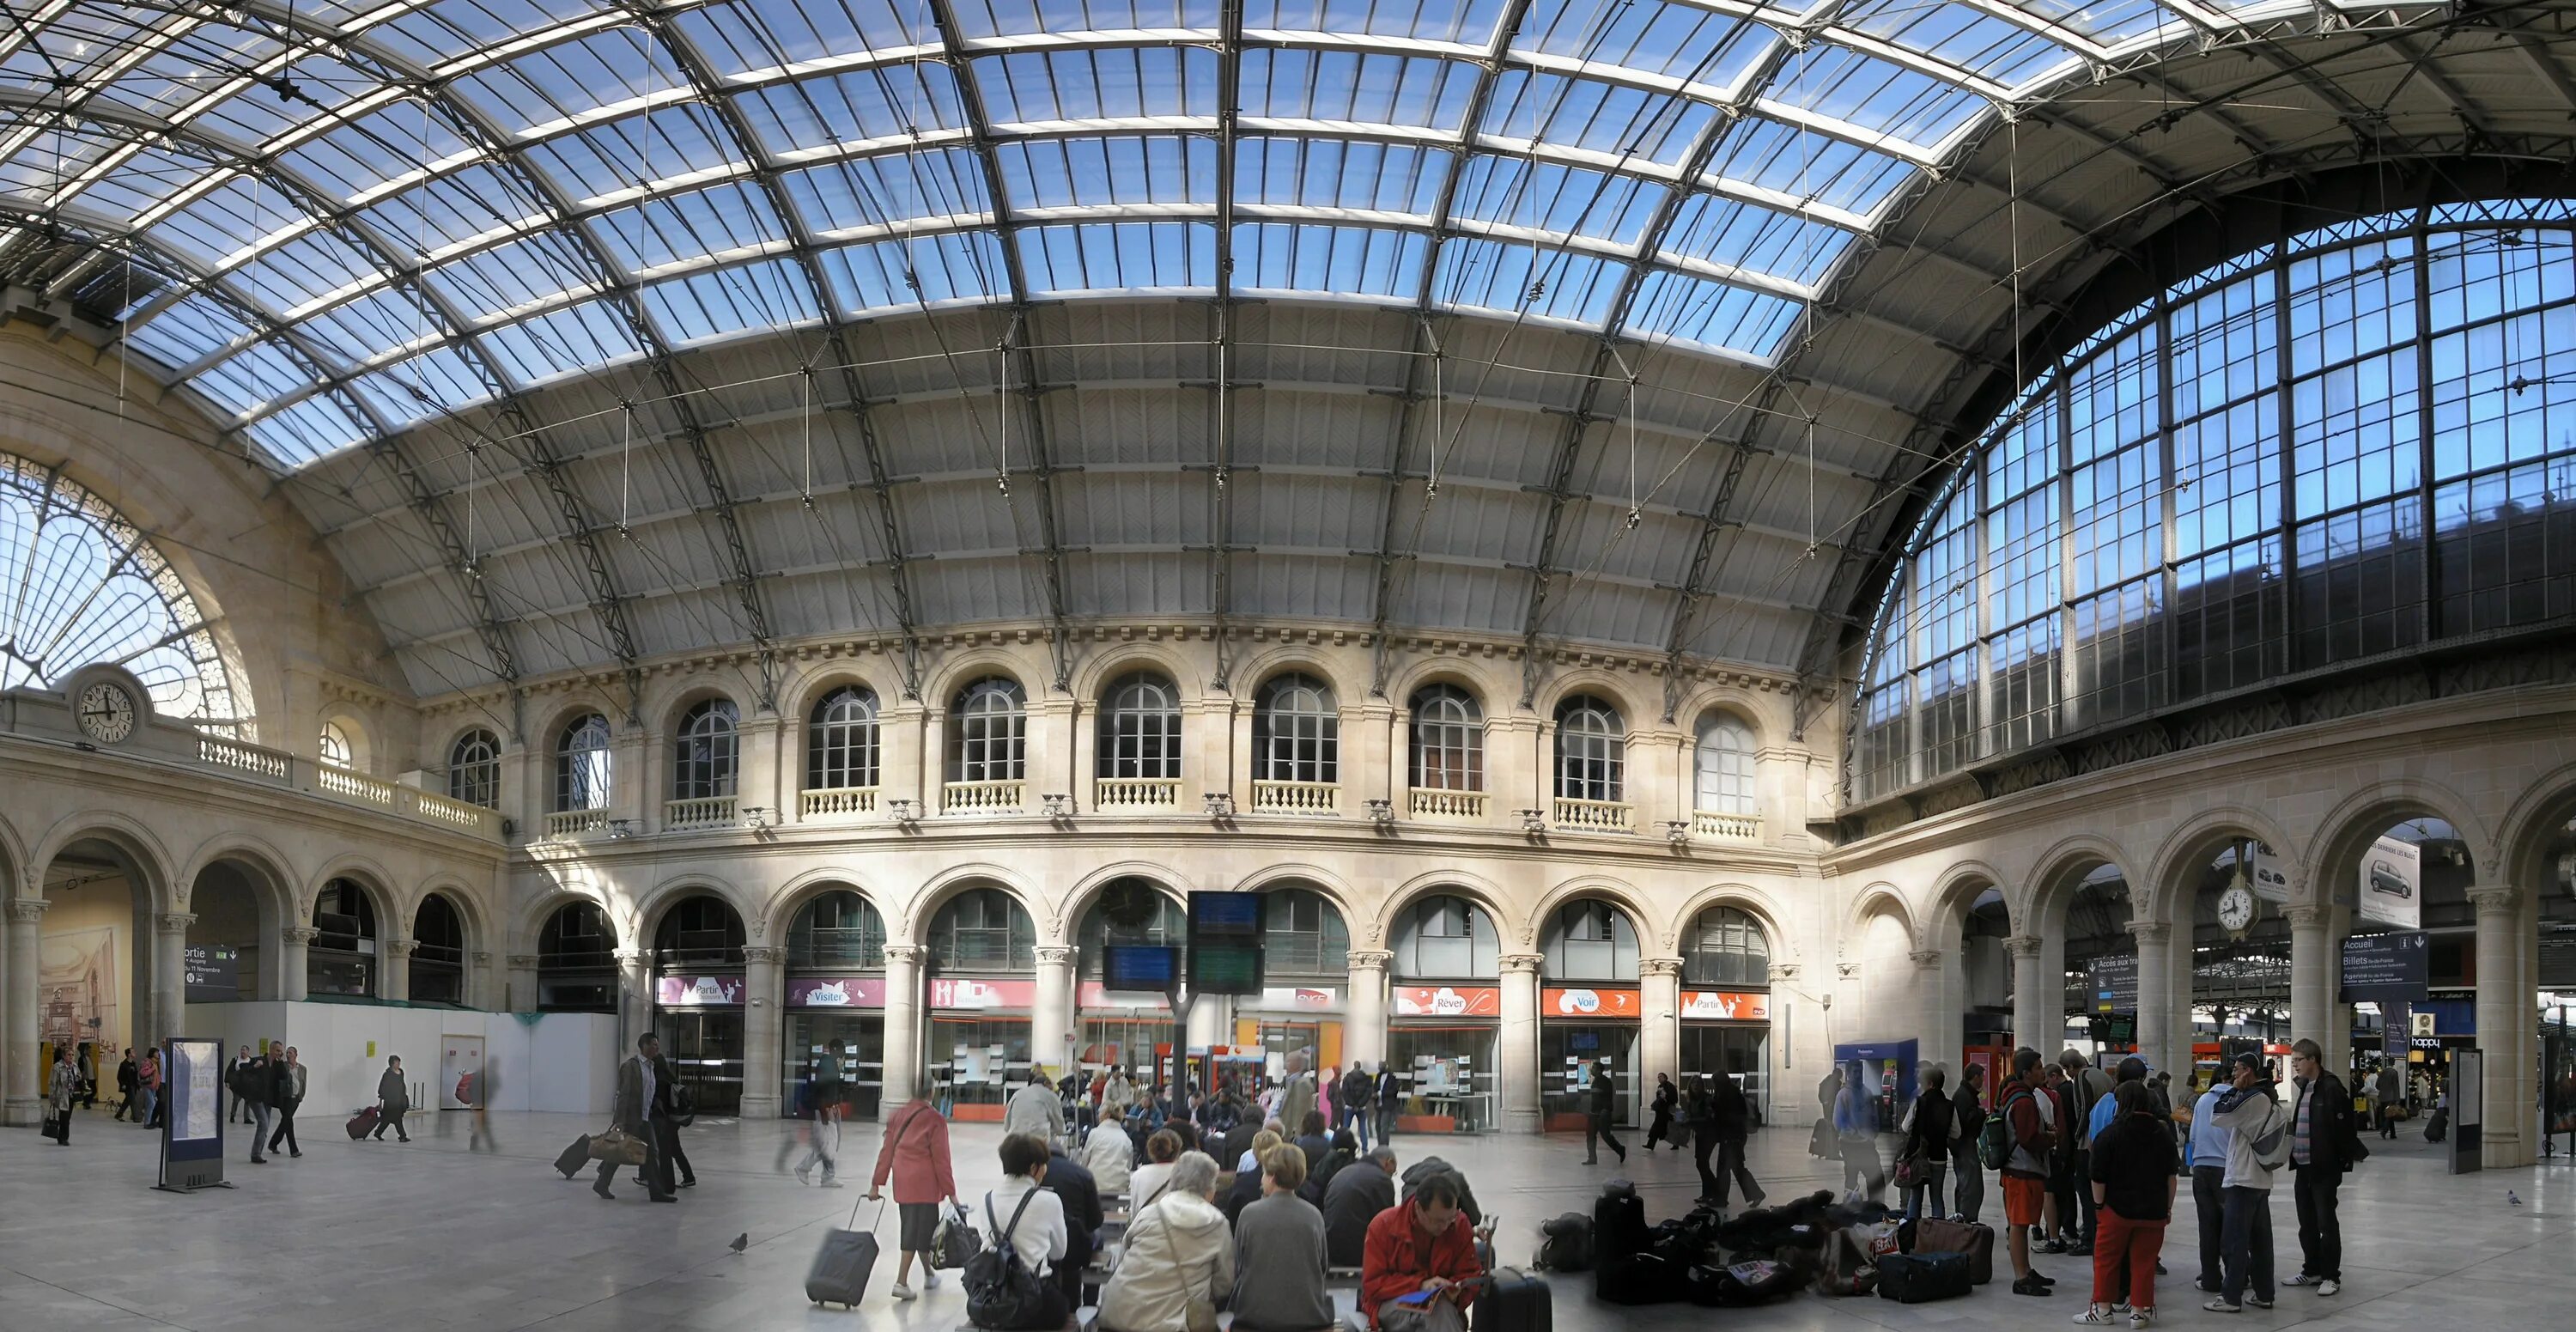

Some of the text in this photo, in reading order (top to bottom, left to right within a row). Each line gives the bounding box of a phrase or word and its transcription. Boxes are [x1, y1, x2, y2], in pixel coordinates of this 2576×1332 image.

[2343, 939, 2373, 950] Accueil
[184, 947, 205, 958] ortie
[2098, 959, 2116, 968] Accès
[2342, 956, 2368, 966] Billets
[696, 984, 719, 995] Partir
[814, 992, 843, 1002] Visiter
[1577, 996, 1596, 1007] Voir
[1697, 999, 1720, 1009] Partir
[2411, 1037, 2440, 1049] happy
